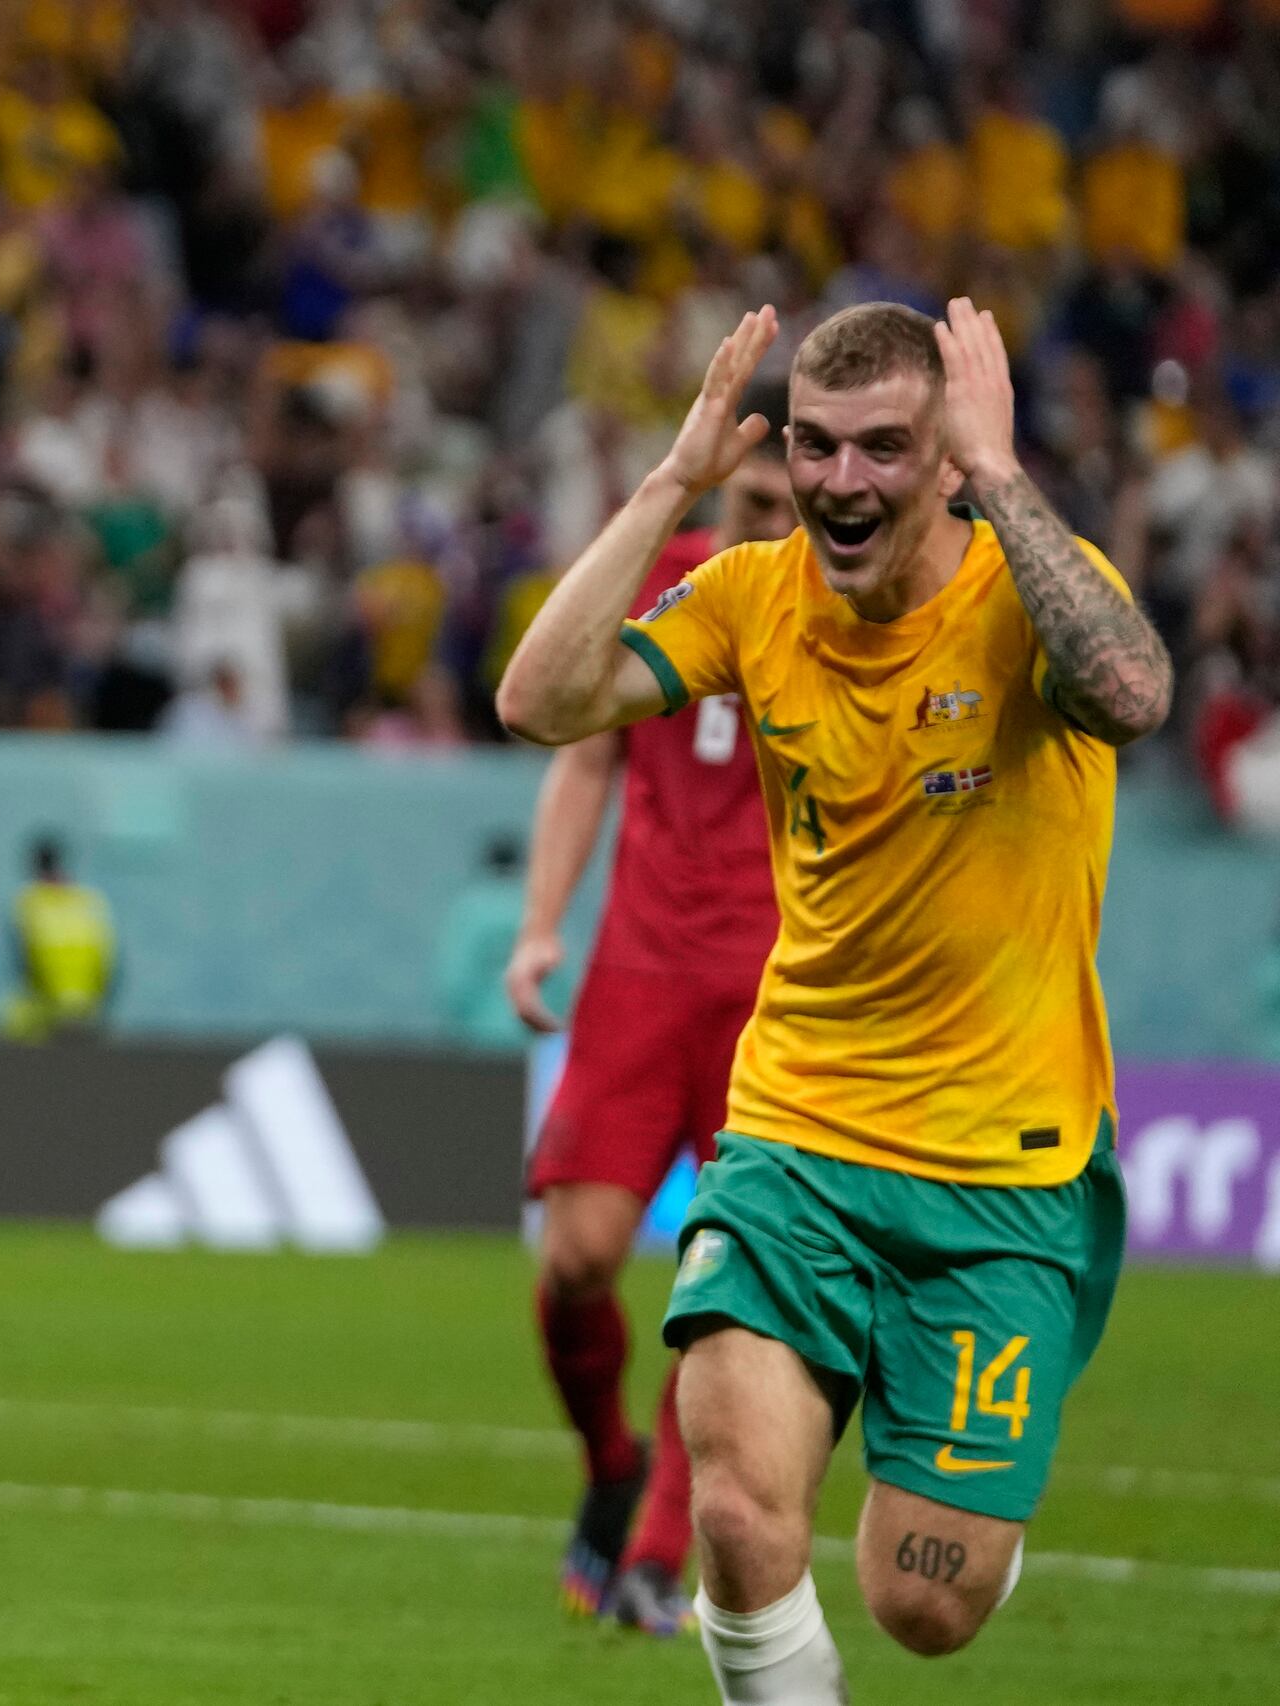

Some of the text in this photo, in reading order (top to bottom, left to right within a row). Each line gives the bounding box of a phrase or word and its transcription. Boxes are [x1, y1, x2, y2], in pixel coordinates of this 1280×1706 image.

[791, 766, 827, 855] 4
[950, 1330, 1031, 1440] 14
[896, 1532, 967, 1584] 609
